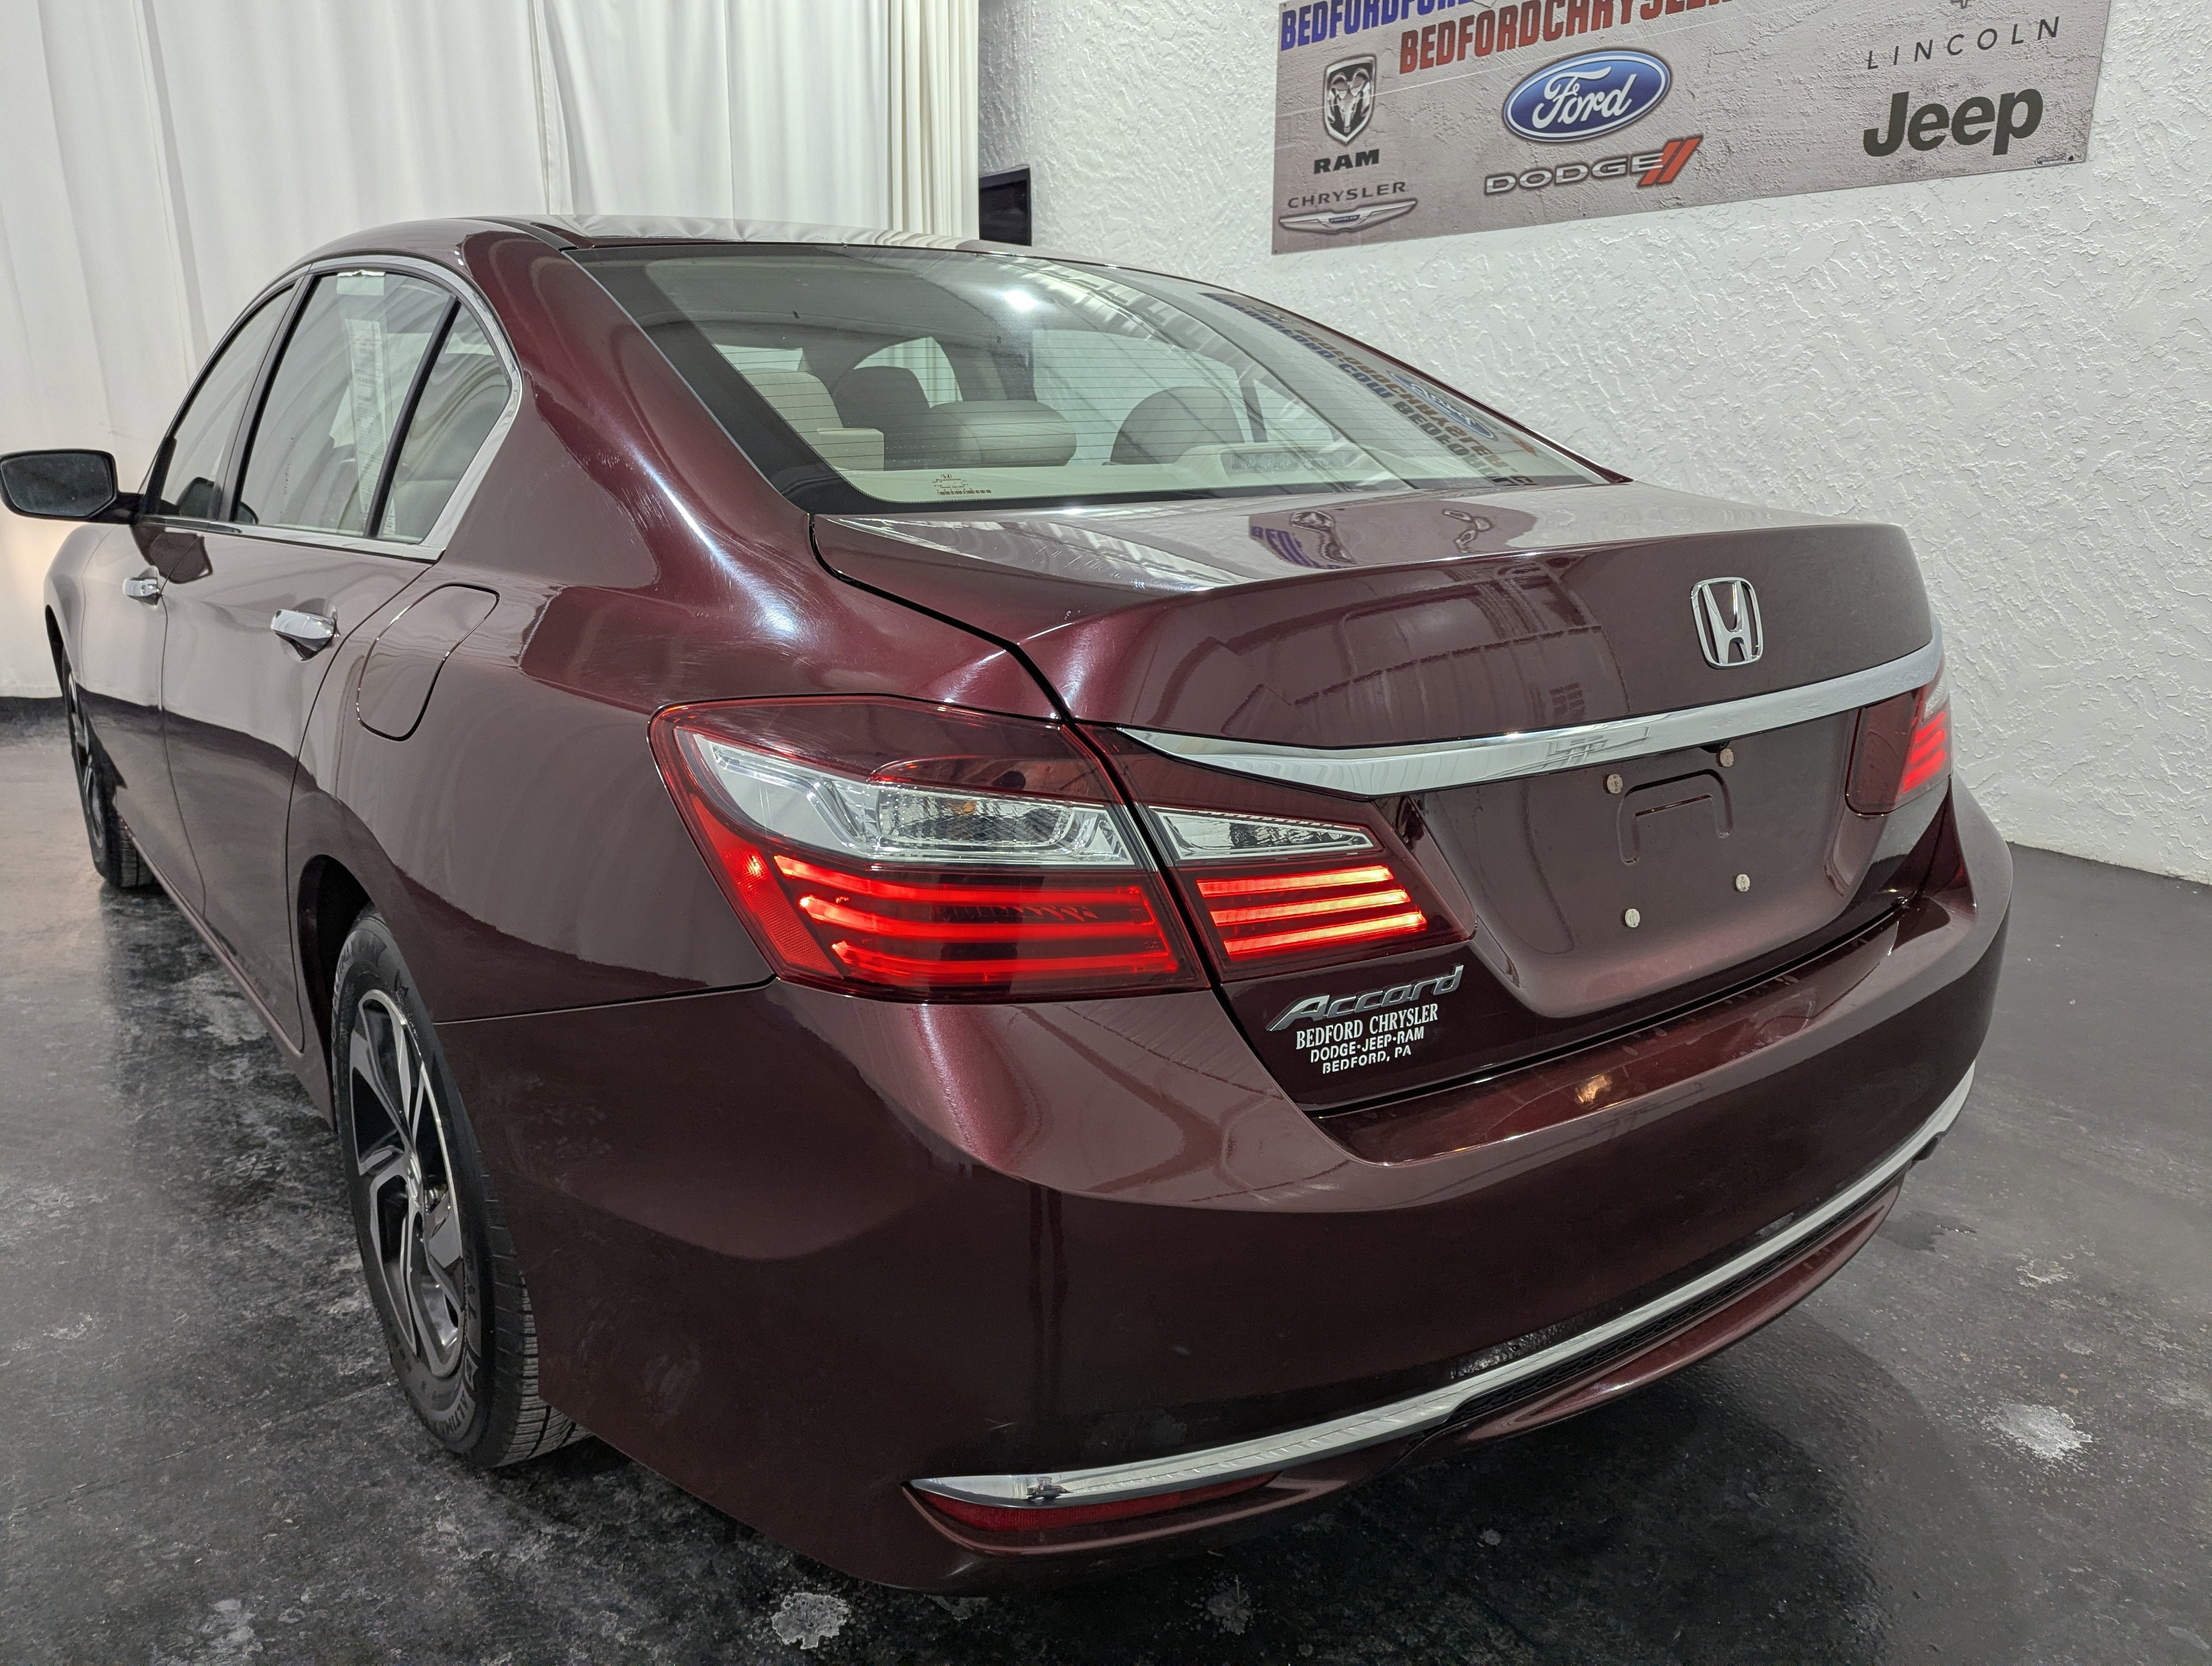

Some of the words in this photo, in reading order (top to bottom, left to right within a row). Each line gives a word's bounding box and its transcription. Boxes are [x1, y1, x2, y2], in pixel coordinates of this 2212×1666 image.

[1867, 16, 2060, 70] LINCOLN
[1532, 66, 1636, 130] Ford
[1863, 88, 2043, 157] Jeep
[1313, 149, 1380, 175] RAM
[1485, 151, 1664, 195] DODGE
[1287, 182, 1406, 209] CHRYSLER
[1266, 964, 1464, 1031] Accord
[1296, 1020, 1363, 1050] BEDFORD
[1369, 1003, 1438, 1035] CHRYSLER
[1322, 1050, 1390, 1074] BEDFORD,
[1395, 1045, 1412, 1059] PA
